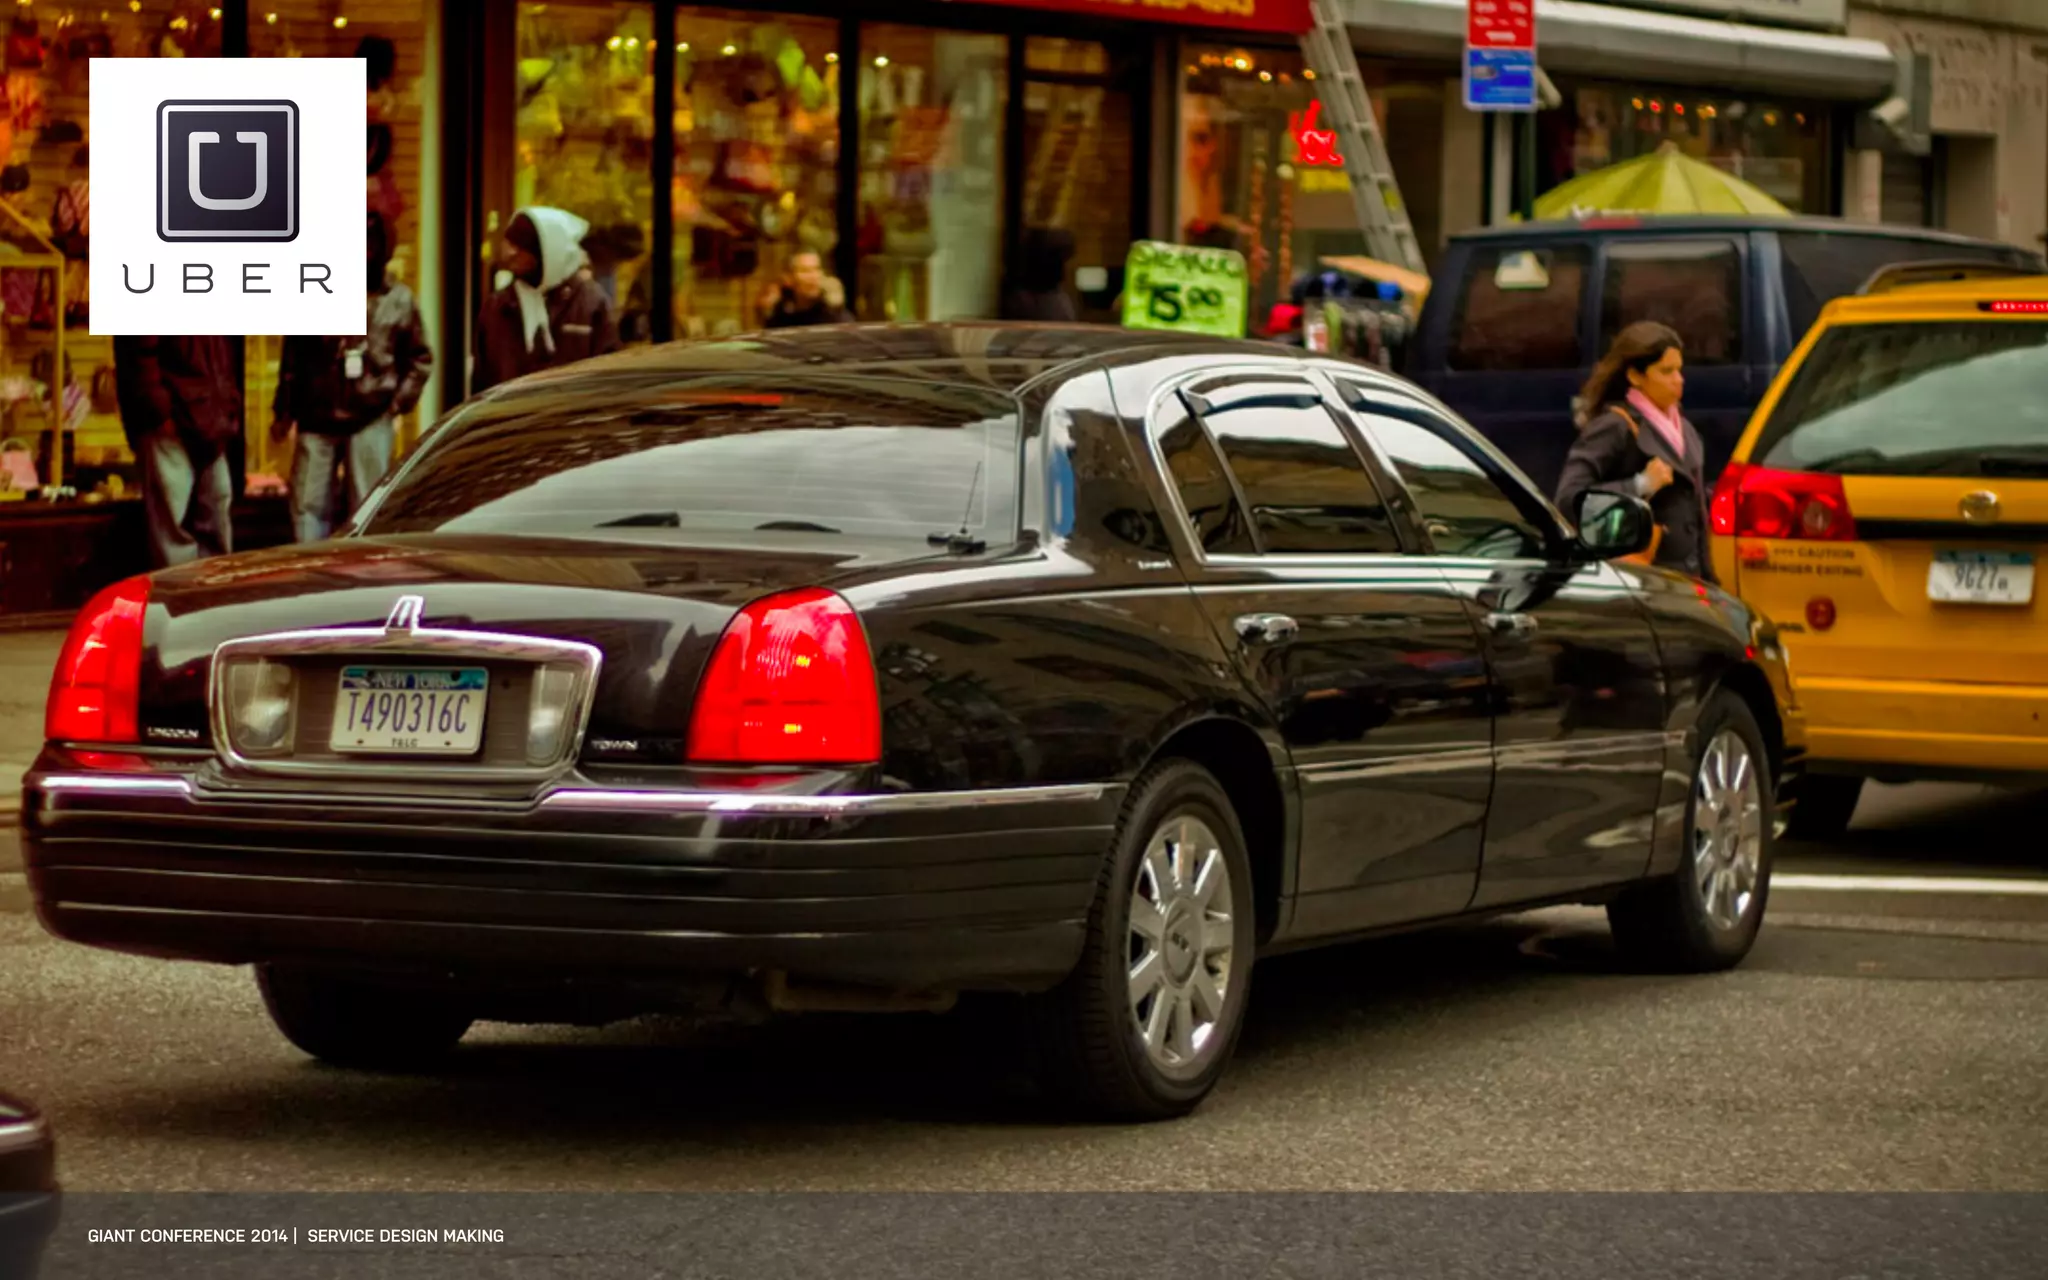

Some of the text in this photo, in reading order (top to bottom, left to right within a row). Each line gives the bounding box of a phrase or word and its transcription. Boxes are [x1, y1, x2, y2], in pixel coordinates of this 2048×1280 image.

[1742, 559, 1813, 574] SENGER
[373, 671, 451, 689] NEW YORK
[347, 692, 470, 733] T490316C
[591, 740, 639, 750] TOWN
